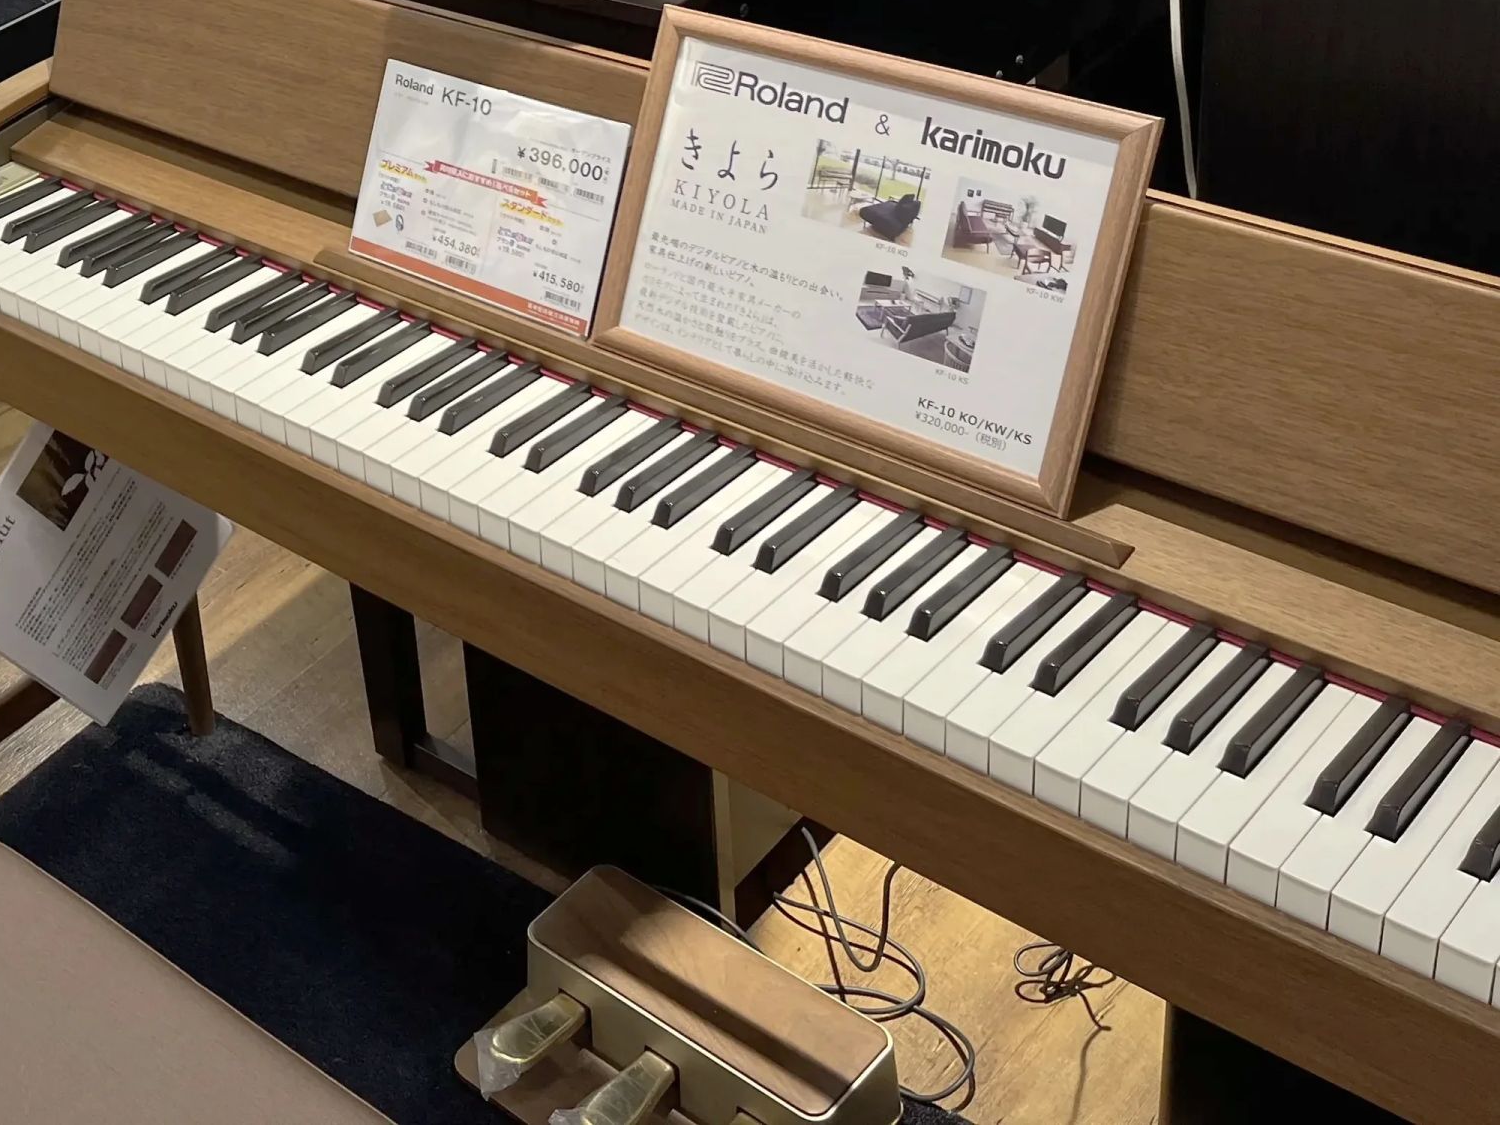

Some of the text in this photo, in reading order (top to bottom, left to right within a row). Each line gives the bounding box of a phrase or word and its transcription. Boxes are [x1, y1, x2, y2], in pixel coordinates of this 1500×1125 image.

[395, 74, 434, 95] Roland
[440, 87, 492, 116] KF-10
[733, 71, 1067, 181] Roland & karimoku
[516, 143, 604, 182] ¥396,000
[682, 129, 781, 191] きよら
[670, 197, 767, 235] MADE IN JAPAN
[673, 178, 772, 221] KIYOLA
[917, 397, 1033, 446] KF-10 KO/KW/KS
